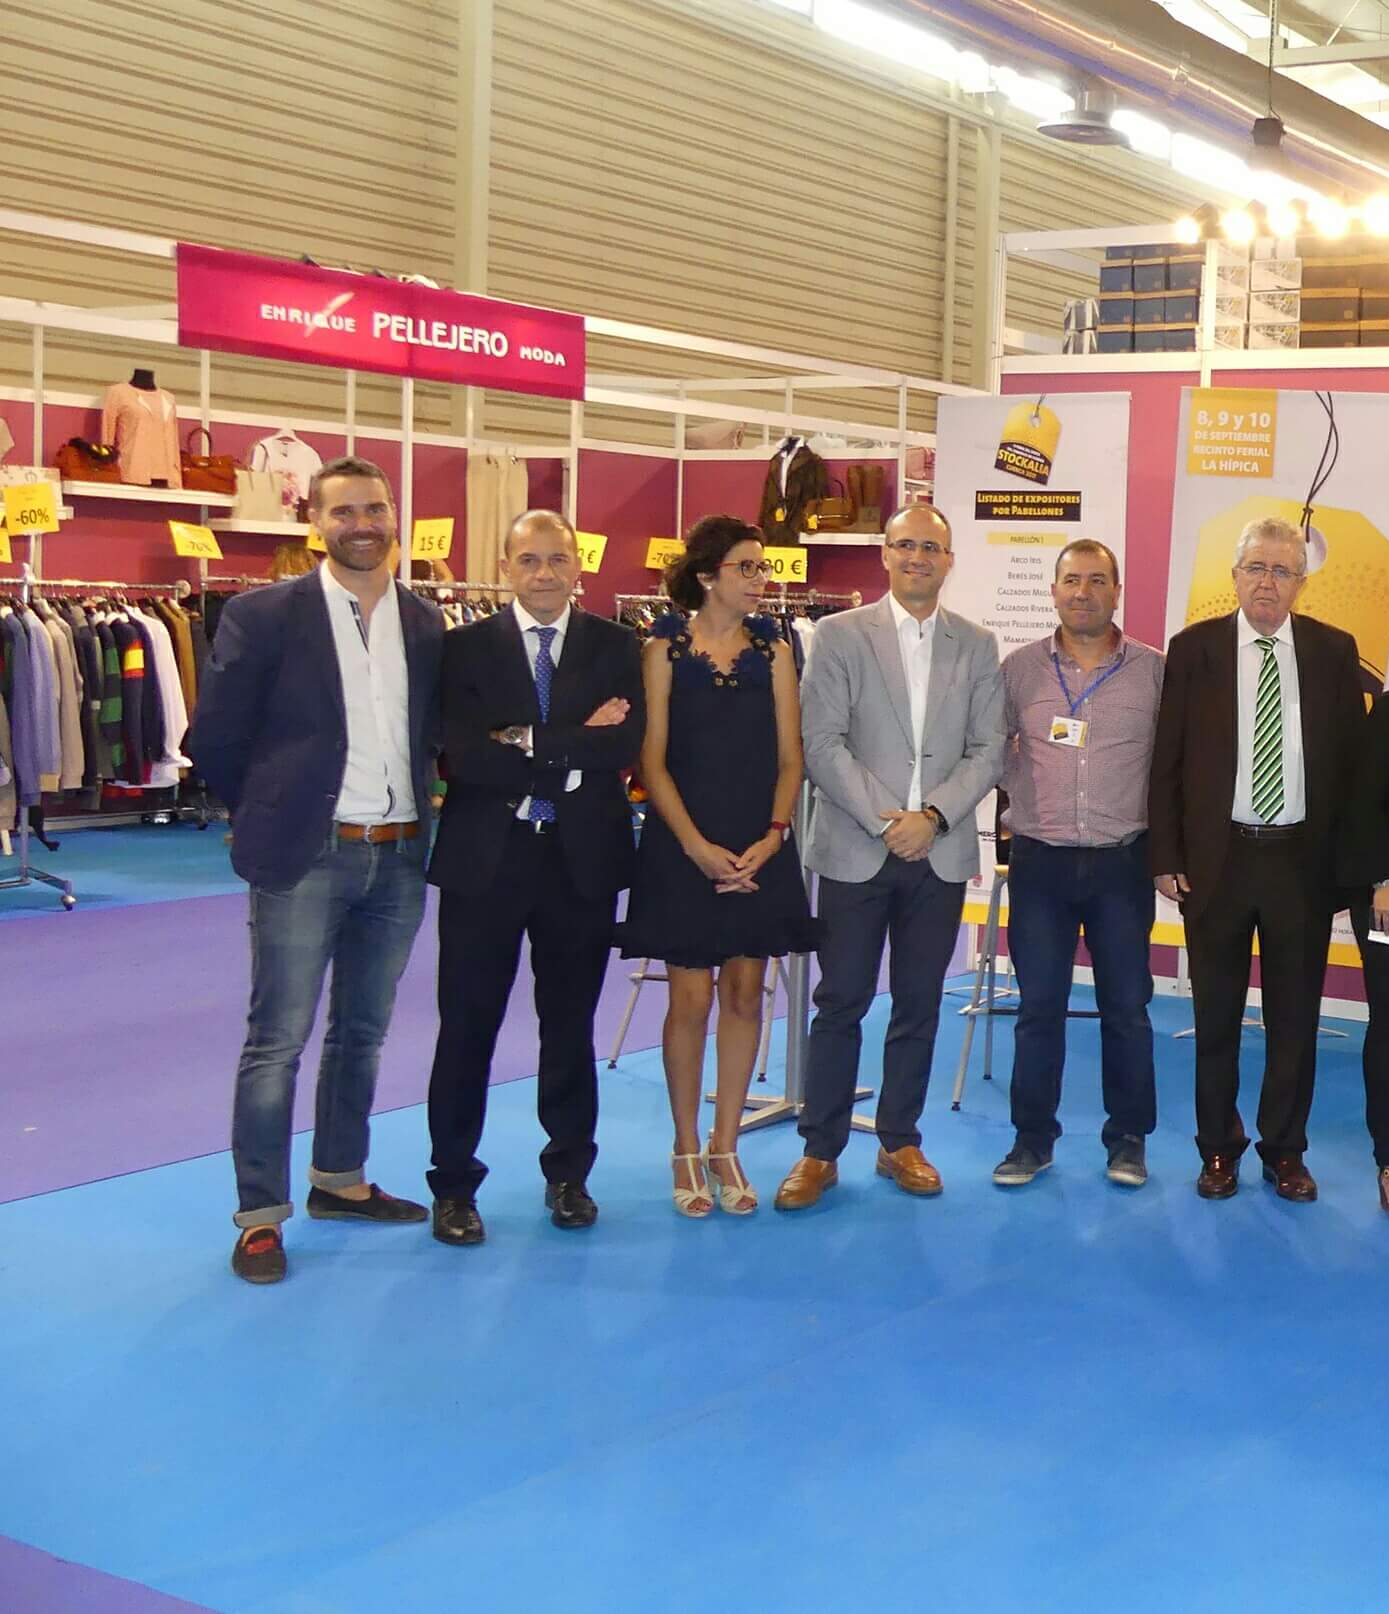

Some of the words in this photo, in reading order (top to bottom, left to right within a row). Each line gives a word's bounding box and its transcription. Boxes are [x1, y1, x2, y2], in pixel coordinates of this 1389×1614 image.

[260, 304, 356, 333] ENRIQUE
[372, 312, 509, 357] PELLEJERO
[519, 345, 566, 366] MODA
[1197, 410, 1213, 427] 8,
[1218, 410, 1229, 426] 9
[1232, 415, 1244, 430] y
[1248, 412, 1271, 428] 10
[1194, 430, 1209, 440] DE
[1209, 431, 1271, 442] SEPTIEMBRE
[1193, 445, 1235, 455] RECINTO
[1236, 447, 1270, 457] FERIAL
[998, 449, 1049, 476] STOCKALIA
[1201, 459, 1216, 470] LA
[1219, 458, 1259, 472] HÍPICA
[977, 493, 1011, 503] LISTADO
[1012, 495, 1024, 503] DE
[1025, 495, 1081, 503] EXPOSITORES
[15, 508, 49, 526] -60%
[992, 507, 1010, 515] POR
[1011, 505, 1064, 516] PABELLONES
[419, 536, 435, 551] 15
[437, 536, 446, 551] €
[791, 559, 802, 575] €
